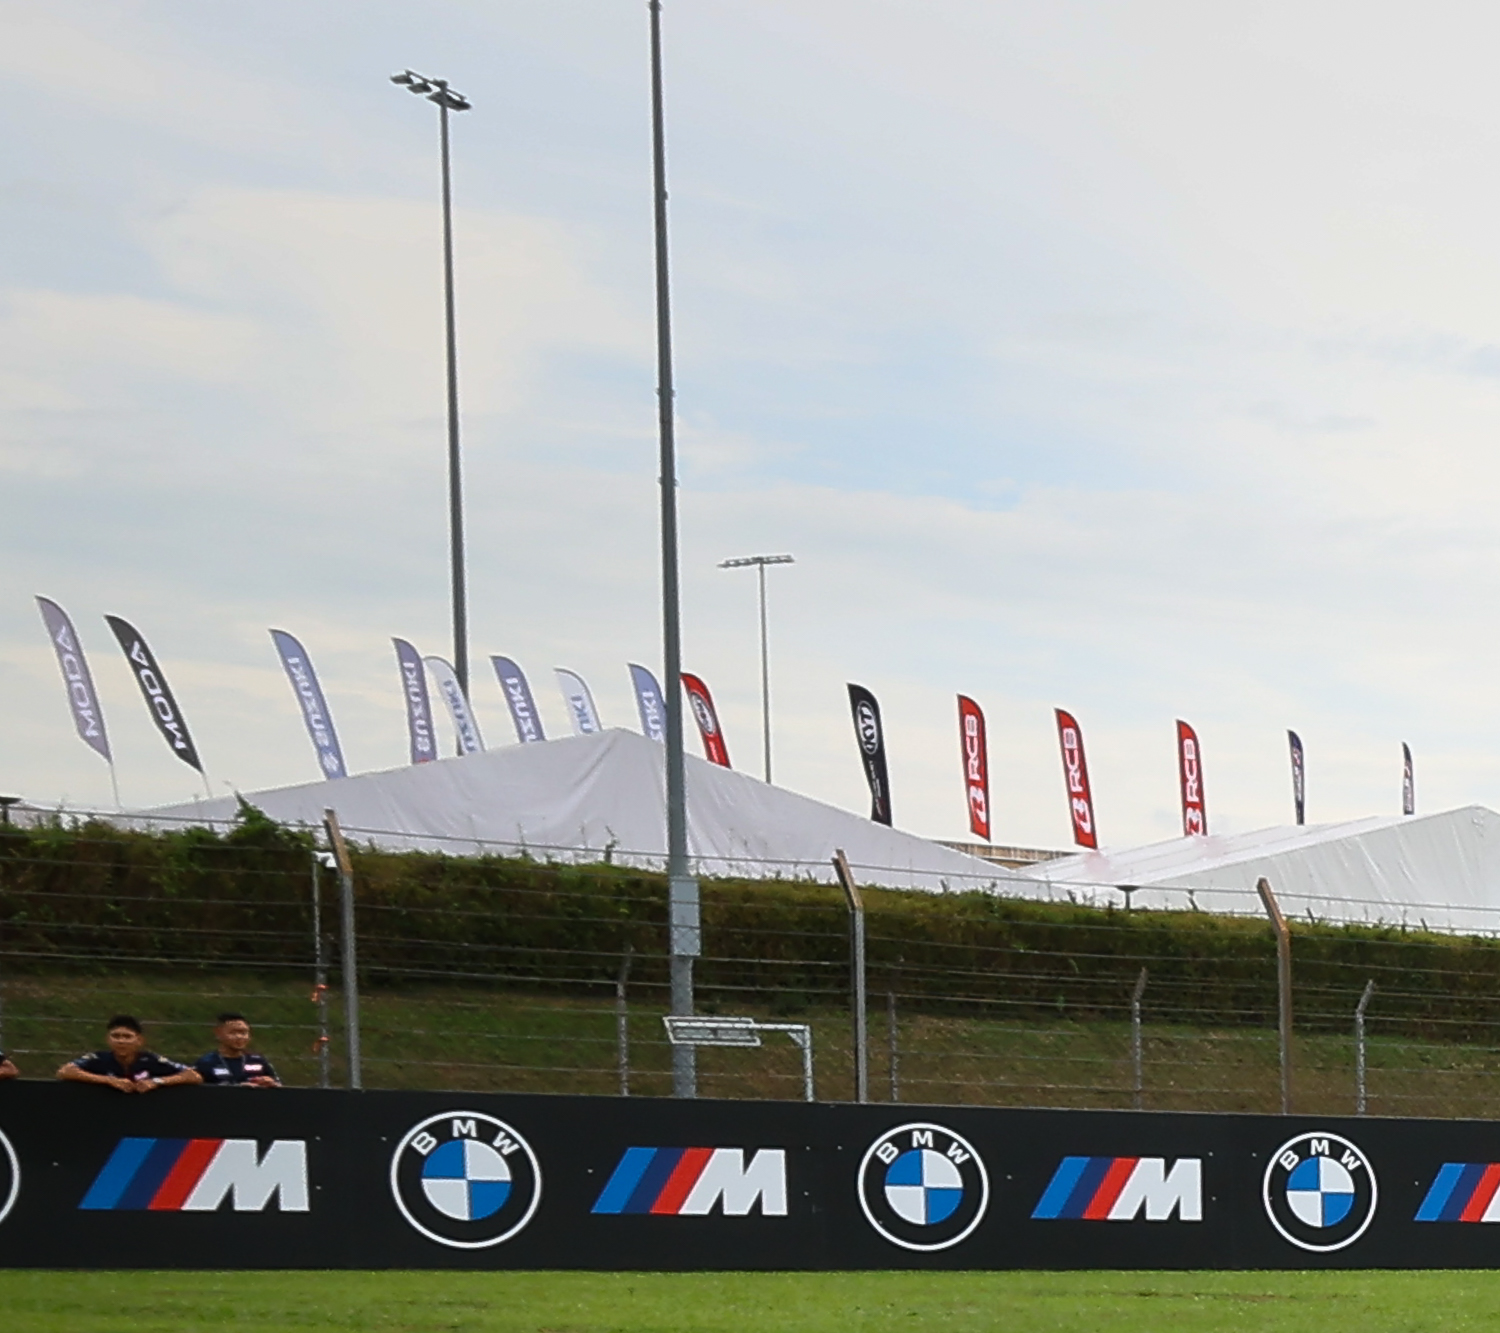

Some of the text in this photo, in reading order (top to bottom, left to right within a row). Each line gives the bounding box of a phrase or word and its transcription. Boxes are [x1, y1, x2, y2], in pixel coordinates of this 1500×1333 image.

[130, 640, 187, 749] MODA
[410, 1119, 520, 1157] BMW
[877, 1131, 971, 1164] BMW
[1280, 1138, 1361, 1172] BMW
